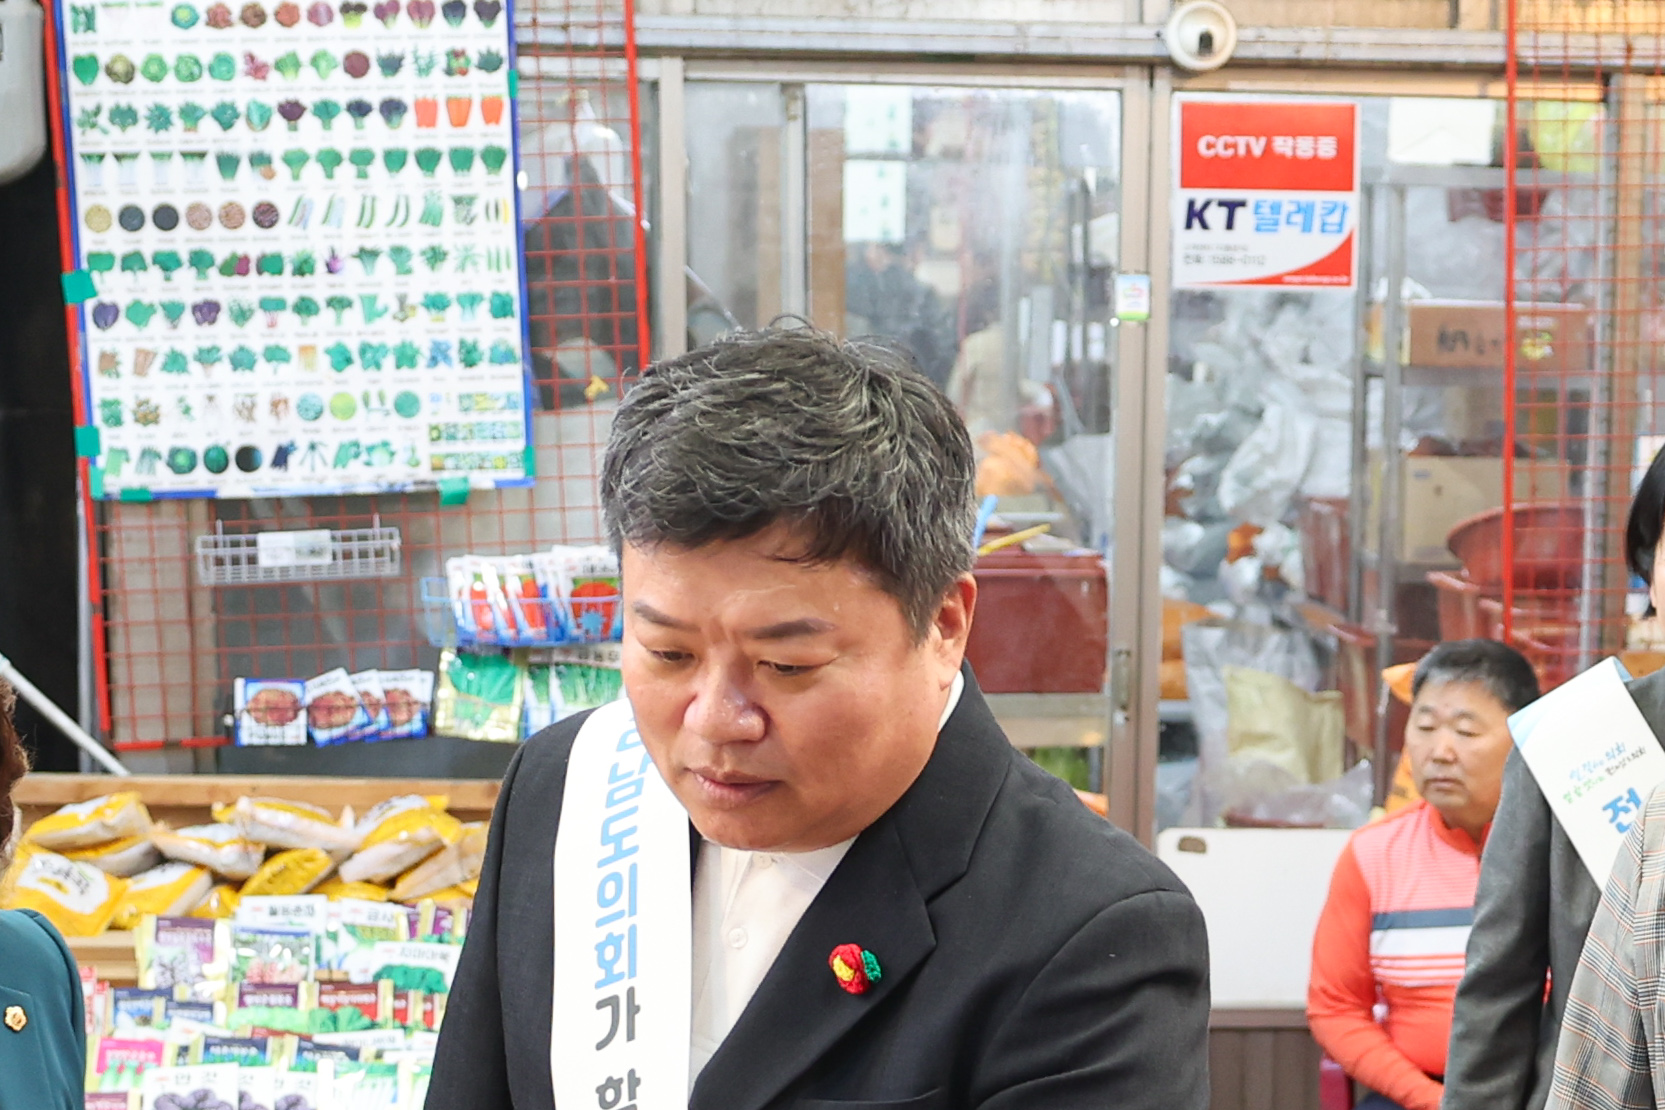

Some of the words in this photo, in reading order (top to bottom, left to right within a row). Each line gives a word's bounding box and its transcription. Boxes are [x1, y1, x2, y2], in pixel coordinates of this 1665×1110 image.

[1197, 134, 1267, 158] CCTV
[1185, 198, 1247, 231] KT
[1253, 199, 1350, 233] 텔레캅
[594, 717, 654, 1051] 남도의회가
